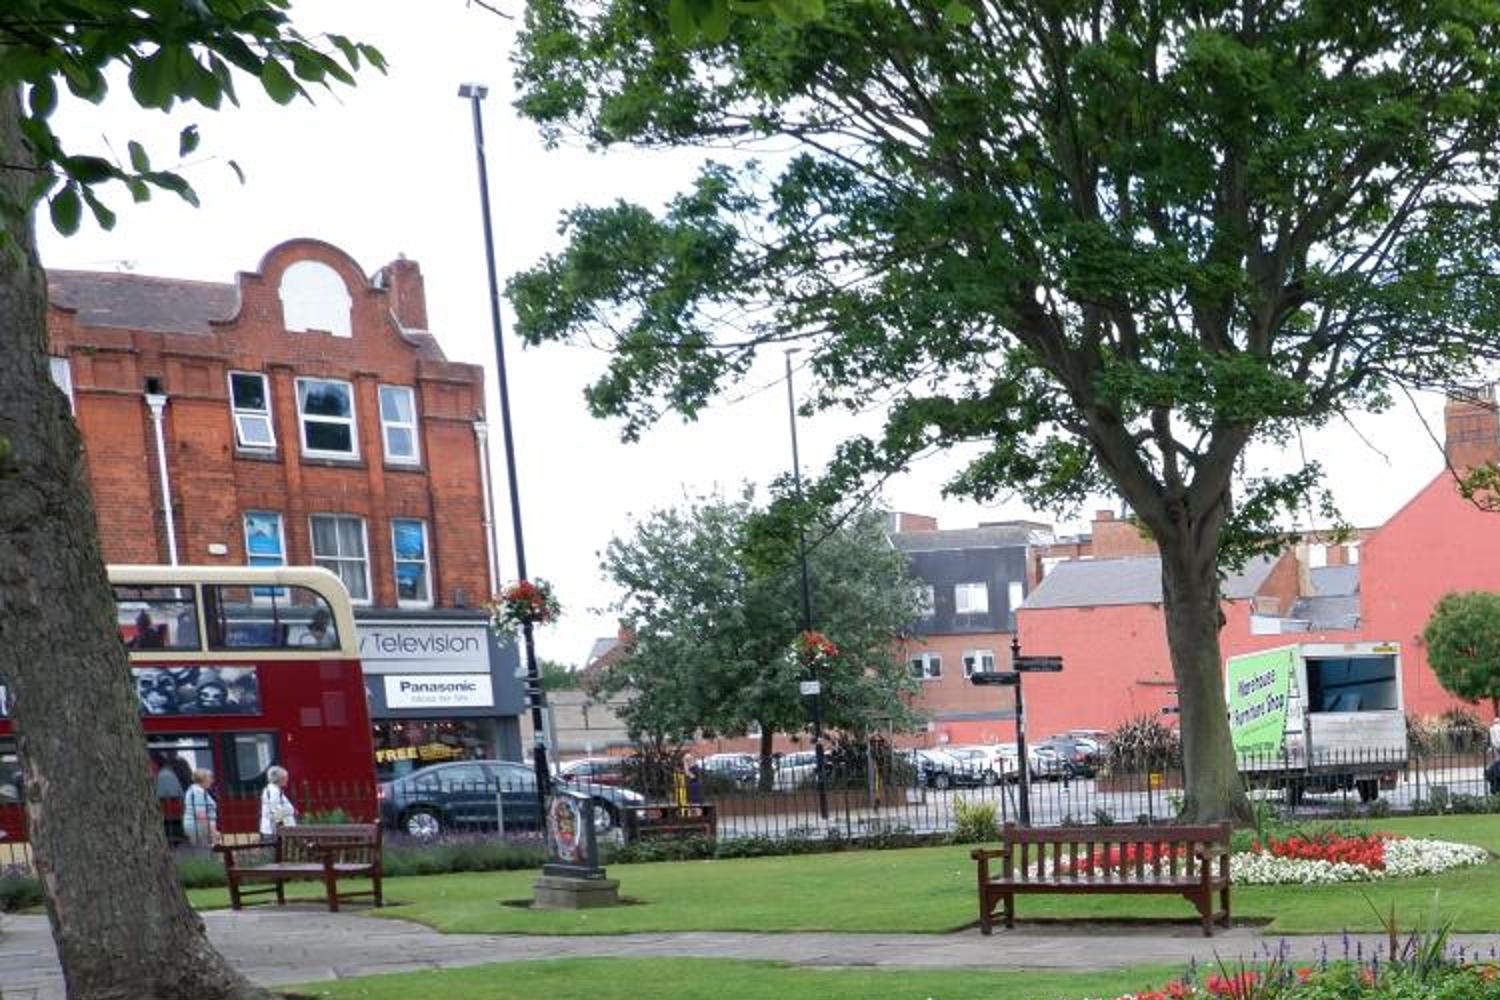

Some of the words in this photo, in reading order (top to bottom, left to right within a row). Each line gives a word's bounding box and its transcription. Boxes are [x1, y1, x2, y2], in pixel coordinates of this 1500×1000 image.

[371, 632, 479, 653] Television
[400, 680, 477, 693] Panasonic
[1266, 693, 1285, 714] Shop
[375, 747, 418, 763] FREE
